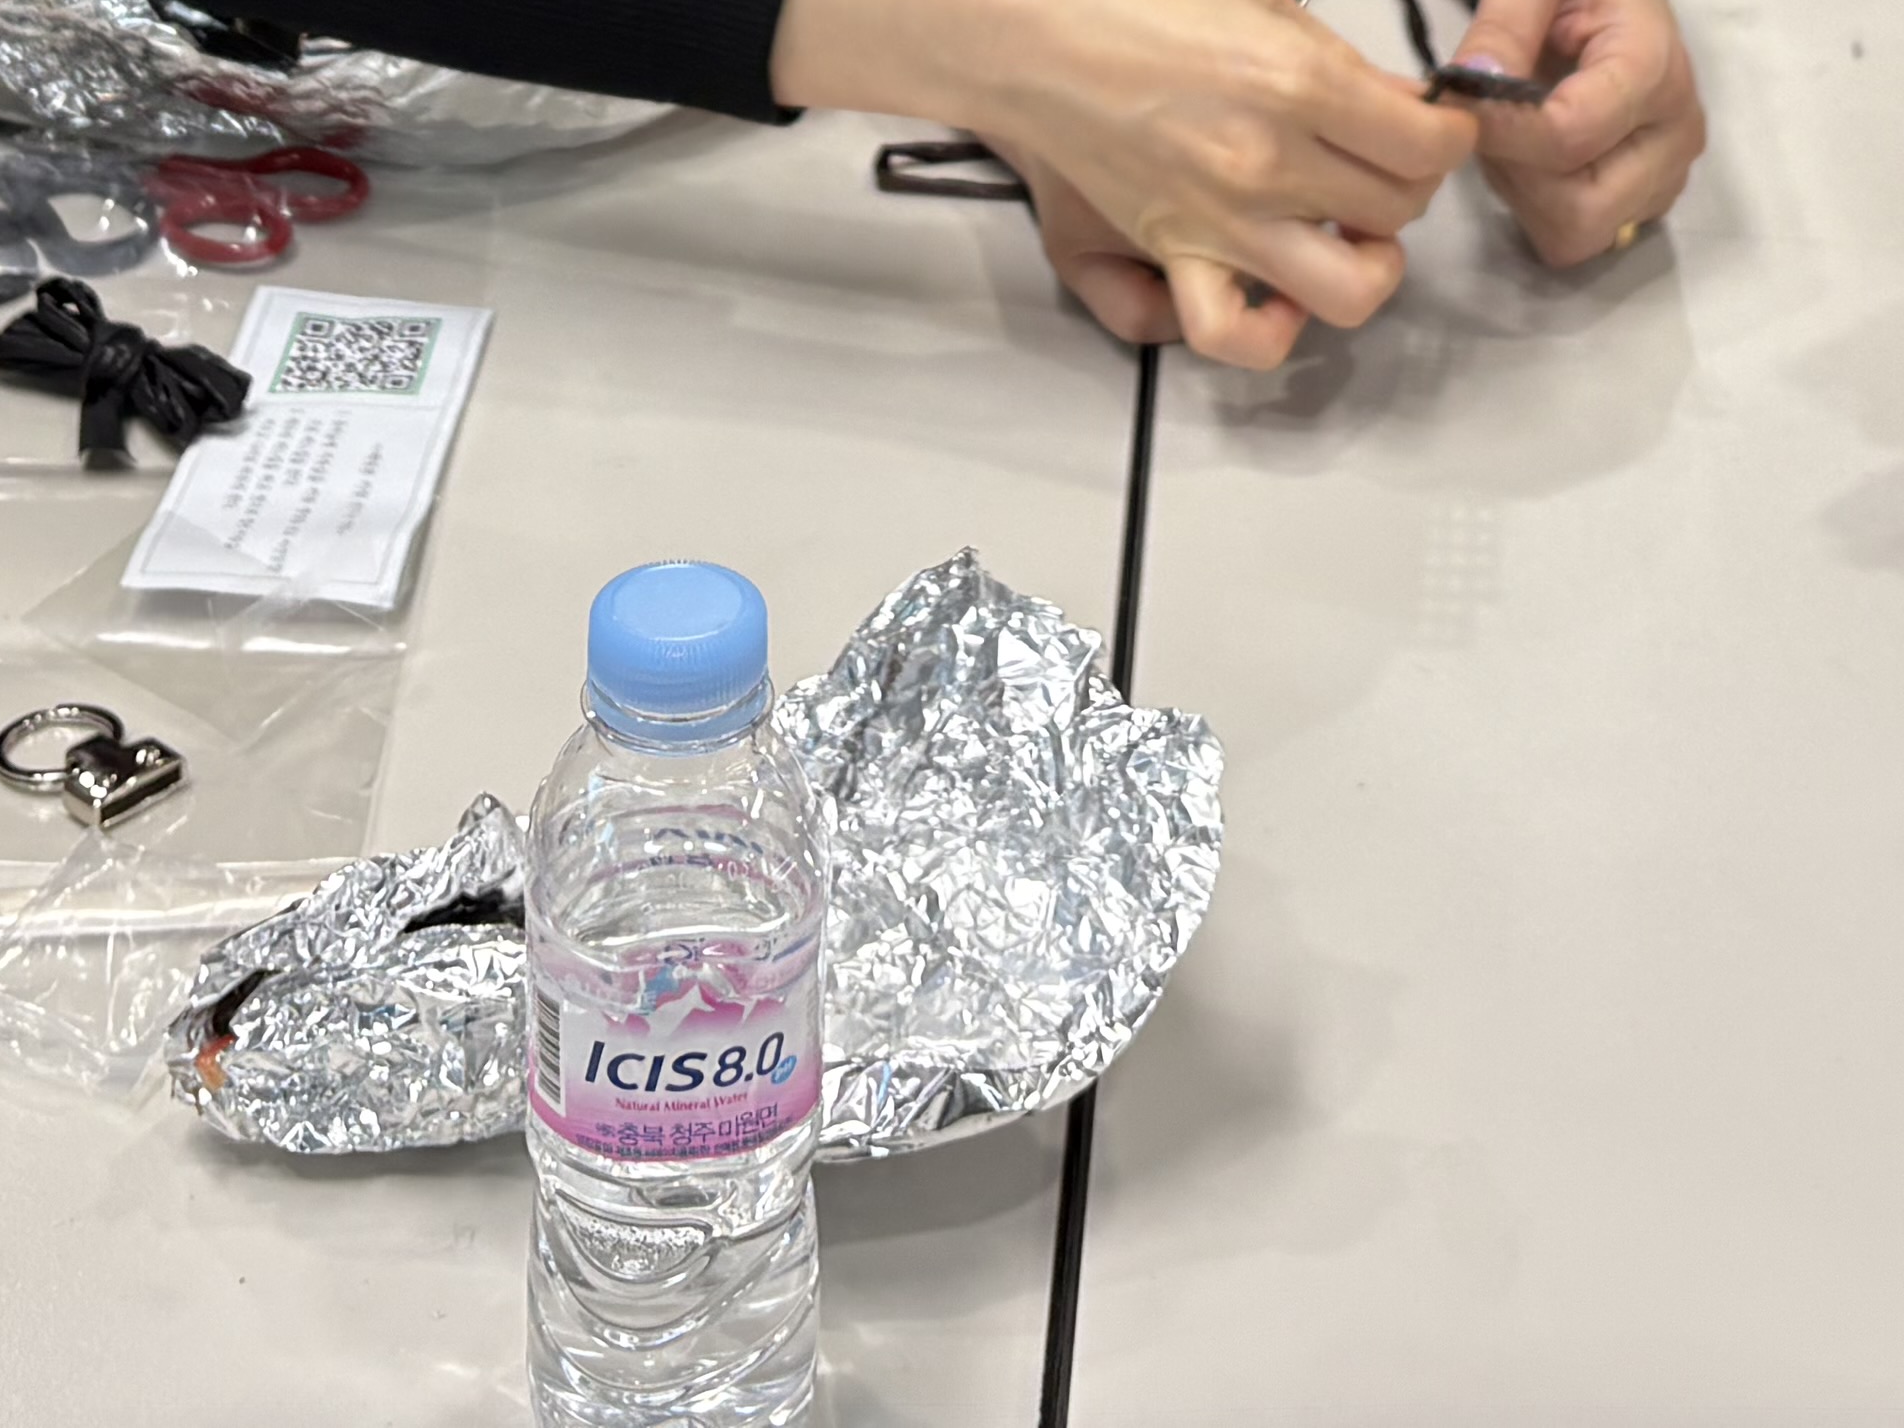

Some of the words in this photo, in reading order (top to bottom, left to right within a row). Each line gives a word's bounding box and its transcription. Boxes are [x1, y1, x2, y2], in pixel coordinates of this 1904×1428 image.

[615, 1097, 660, 1112] Natural
[663, 1098, 711, 1112] Mineral
[713, 1092, 749, 1108] Water
[617, 1121, 665, 1146] 충북
[669, 1121, 716, 1145] 청주
[718, 1102, 778, 1137] 미원면
